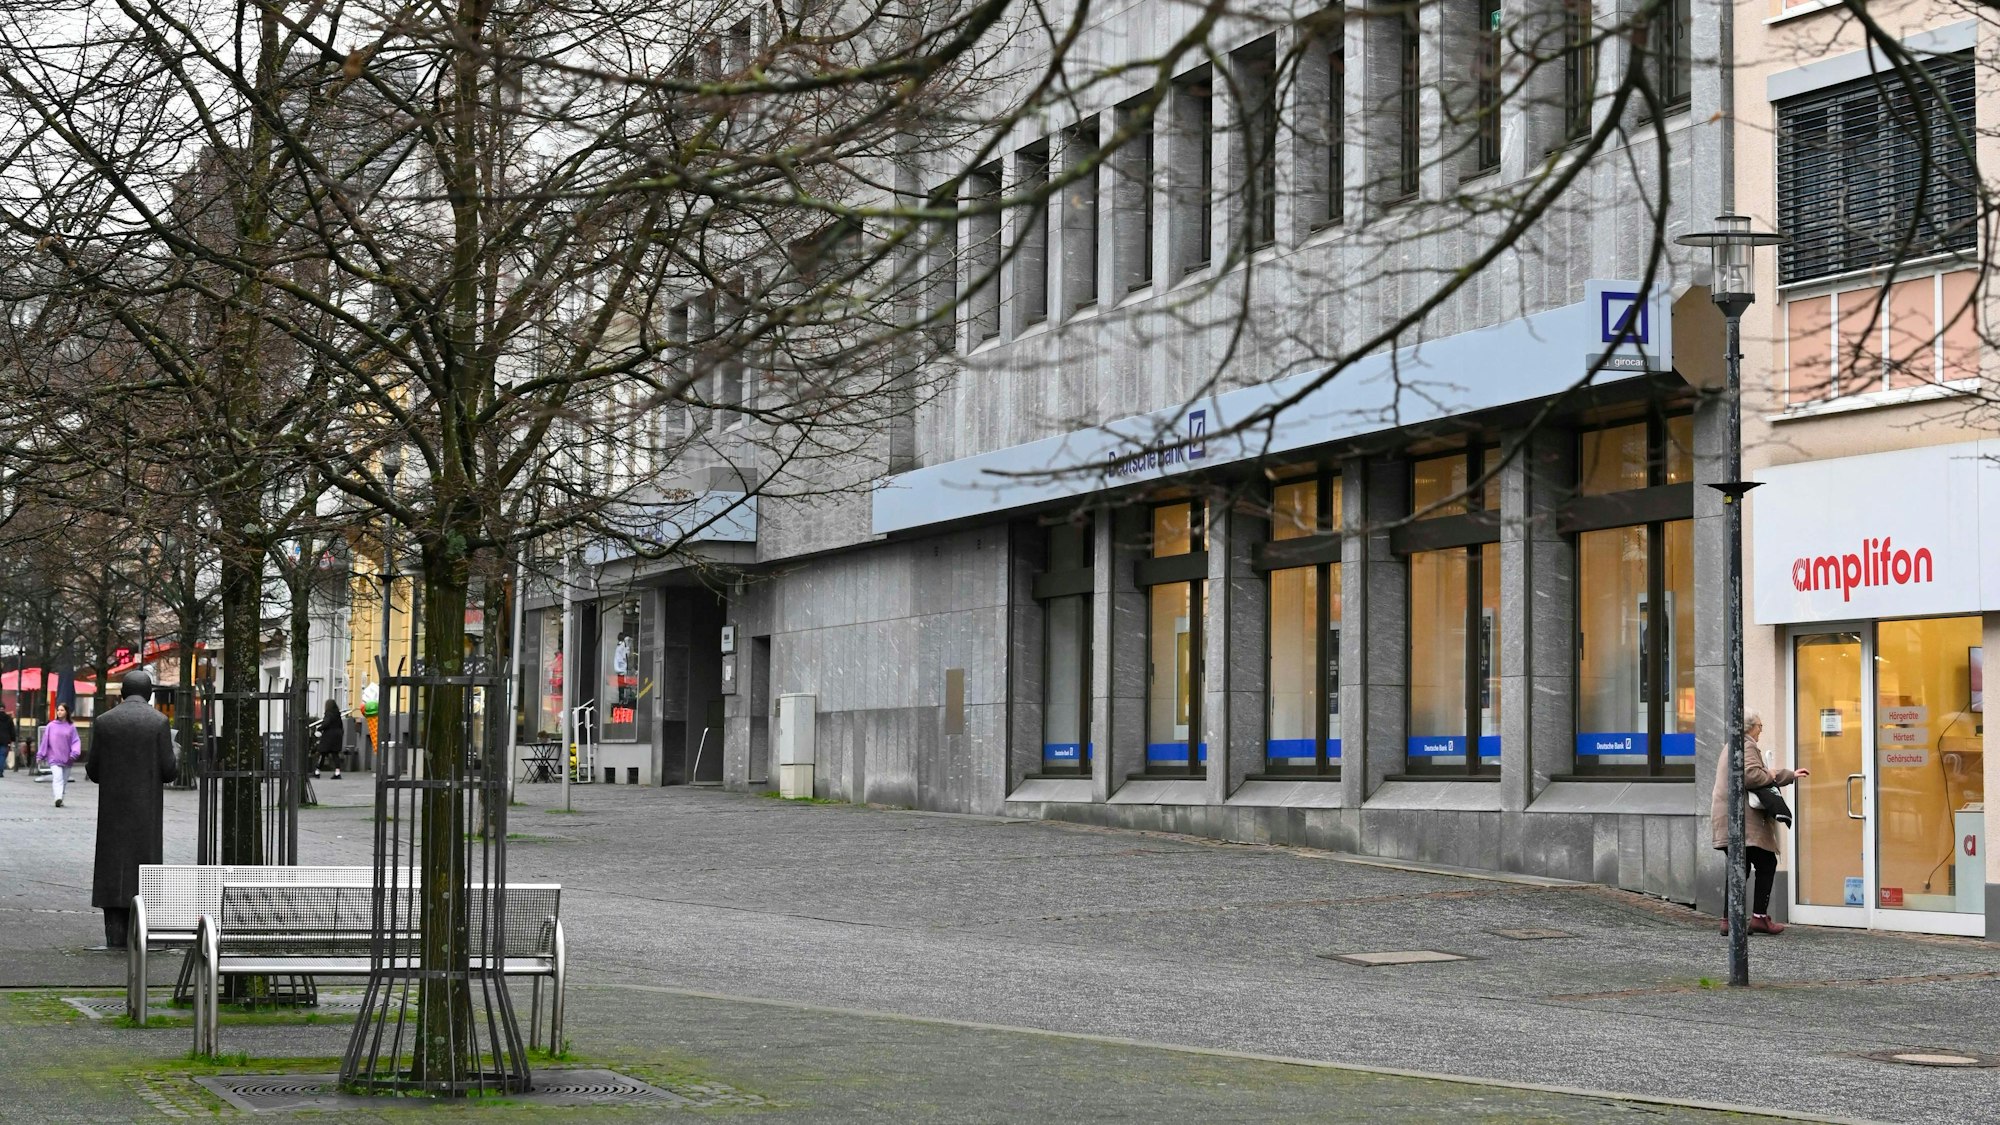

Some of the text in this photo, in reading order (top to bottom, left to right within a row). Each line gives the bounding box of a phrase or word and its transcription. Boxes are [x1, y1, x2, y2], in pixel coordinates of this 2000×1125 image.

[1157, 435, 1184, 467] Bank
[1792, 536, 1933, 602] amplifon
[1889, 711, 1919, 722] Hörgeräte
[1893, 733, 1915, 742] Hörtest
[1887, 754, 1922, 763] Gehörschutz
